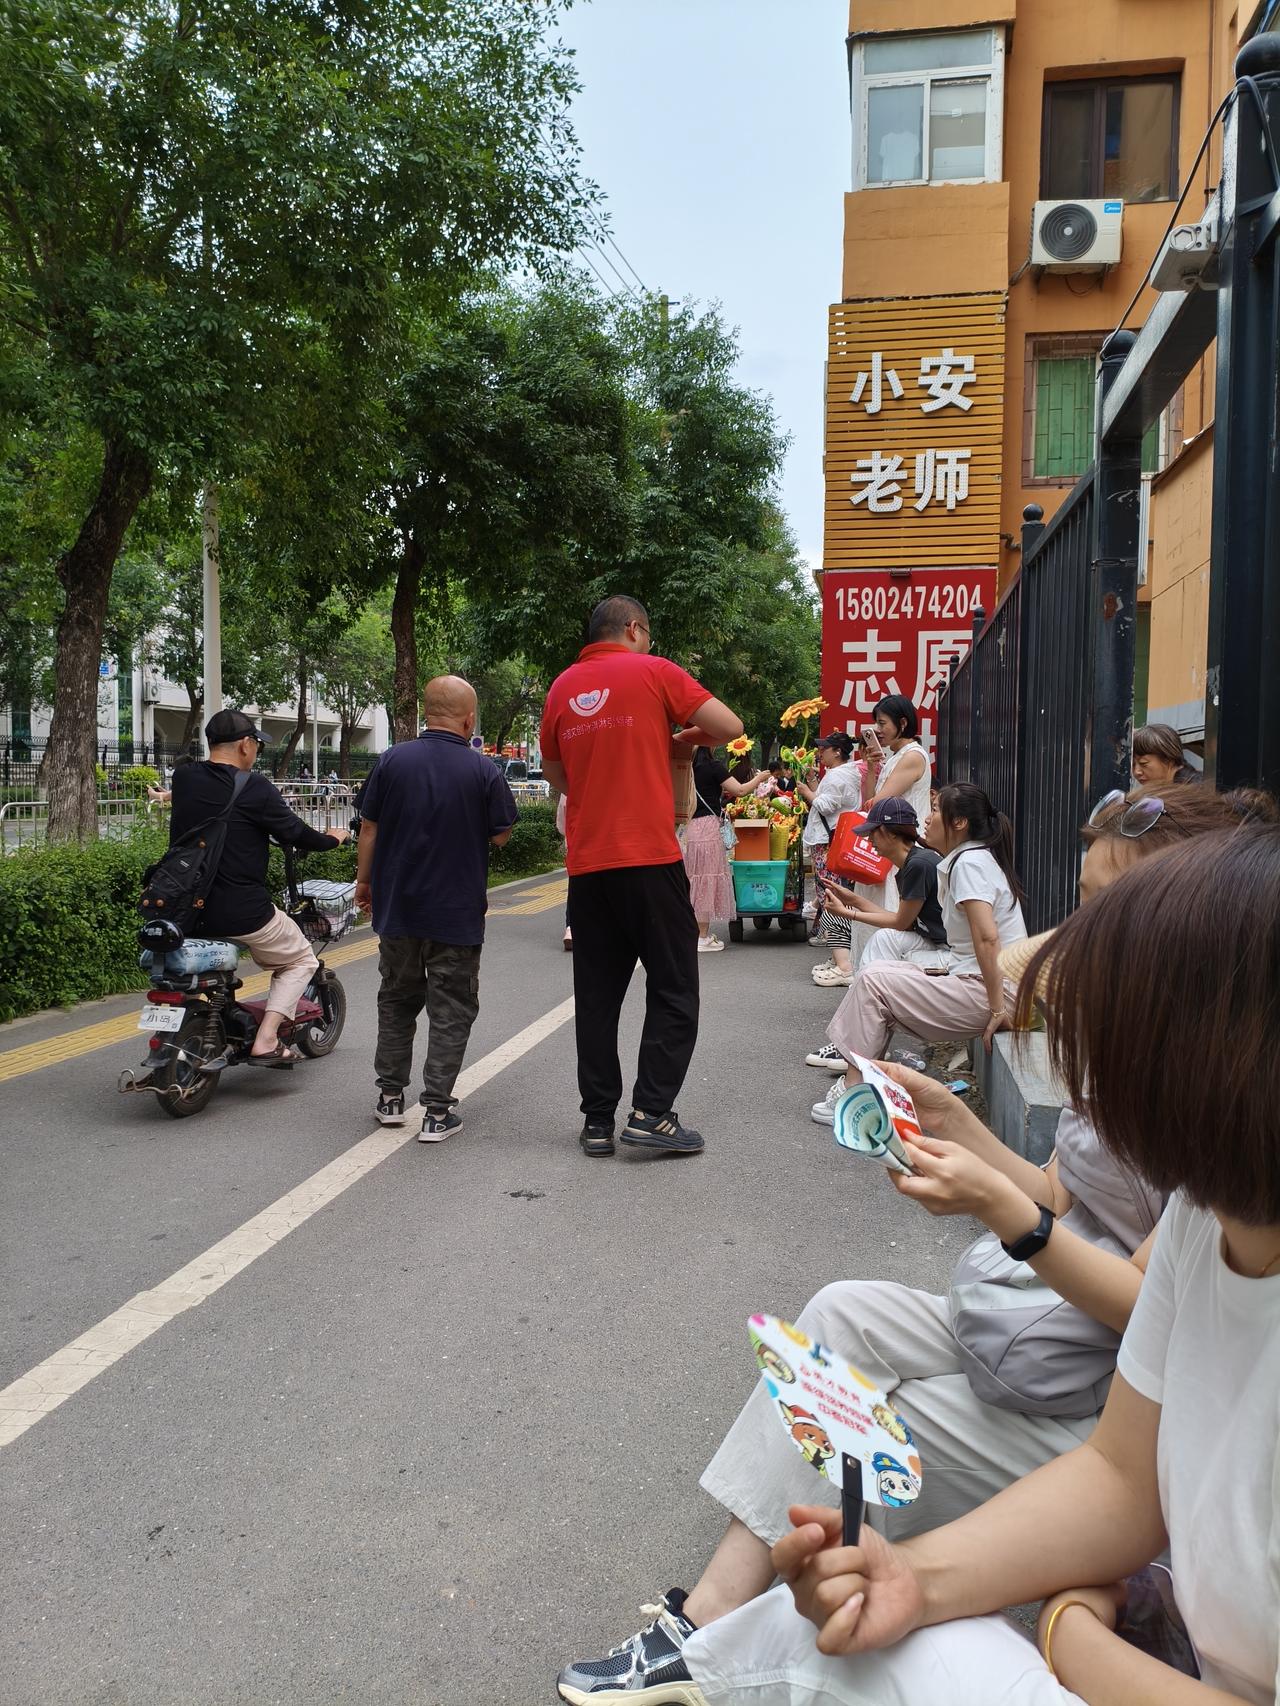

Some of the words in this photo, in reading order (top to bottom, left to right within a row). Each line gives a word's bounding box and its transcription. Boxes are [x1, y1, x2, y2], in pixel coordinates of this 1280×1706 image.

[849, 347, 977, 414] 小安
[849, 448, 972, 513] 老师
[835, 584, 983, 621] 15802474204
[839, 628, 973, 713] 志愿
